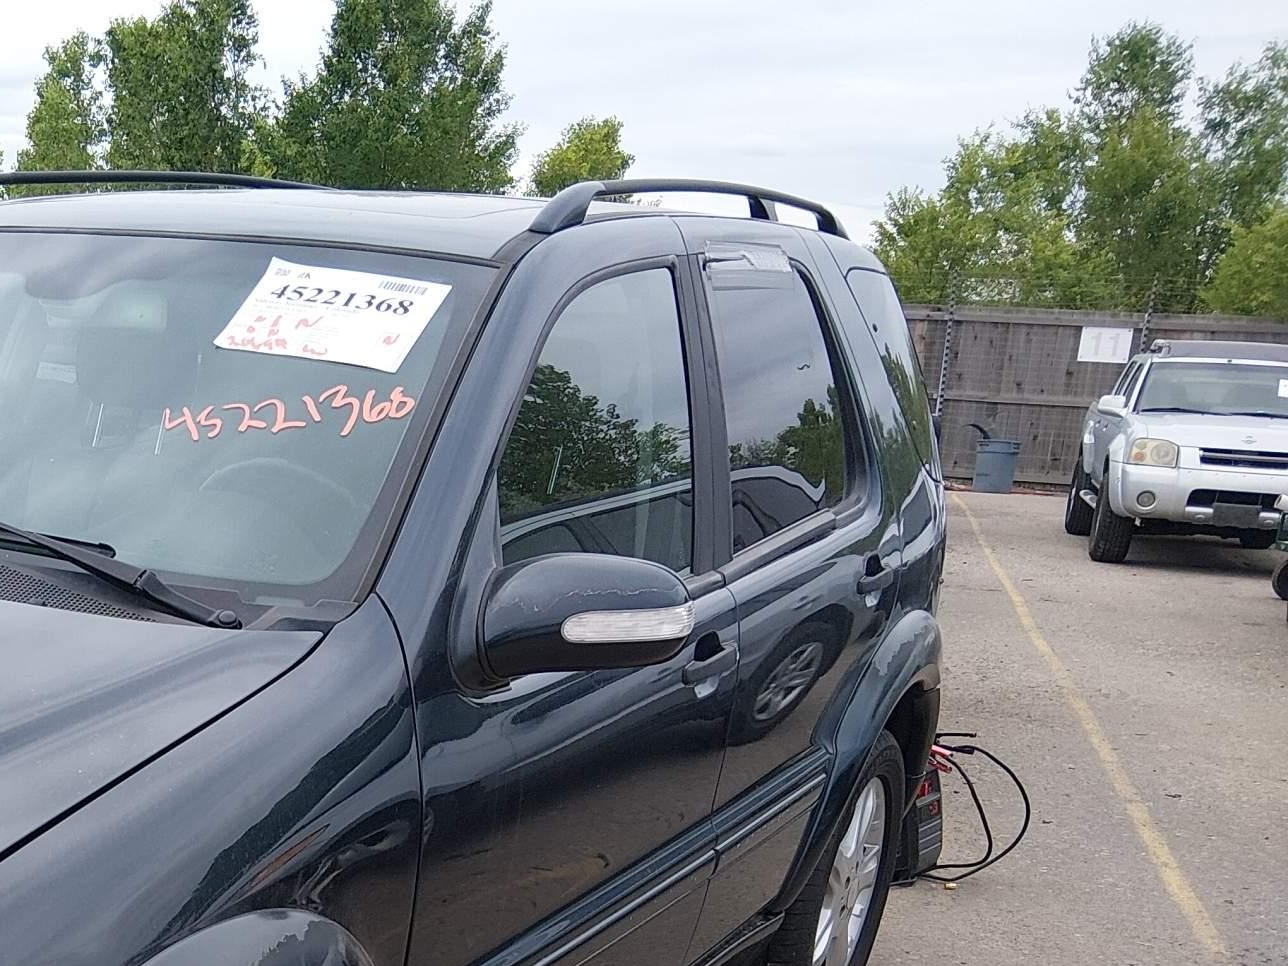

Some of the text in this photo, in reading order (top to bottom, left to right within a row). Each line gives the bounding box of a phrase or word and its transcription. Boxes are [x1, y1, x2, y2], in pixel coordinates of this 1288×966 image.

[269, 284, 415, 316] 45221368
[1091, 332, 1121, 357] 11
[163, 384, 416, 441] 45221368
